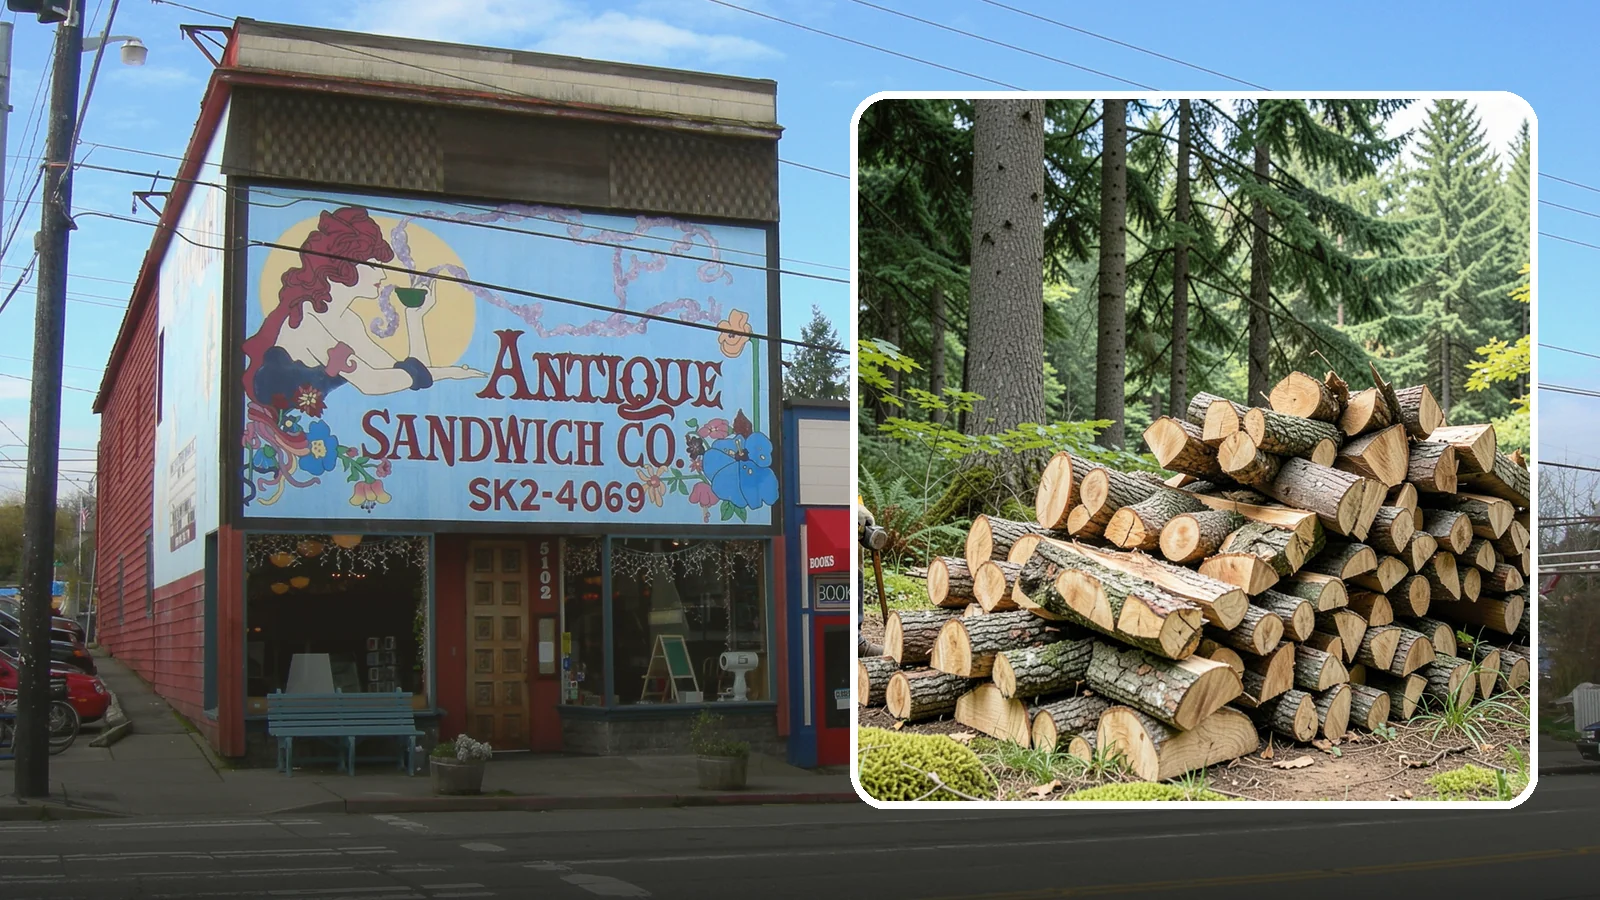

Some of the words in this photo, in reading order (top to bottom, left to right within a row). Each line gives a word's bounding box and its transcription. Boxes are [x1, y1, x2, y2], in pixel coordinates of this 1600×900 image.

[476, 329, 723, 421] ANTIQUE
[361, 408, 605, 468] SANDWICH
[617, 422, 685, 469] CO.
[468, 477, 646, 514] SK2-4069
[539, 542, 552, 600] 5102
[809, 555, 835, 569] BOOKS
